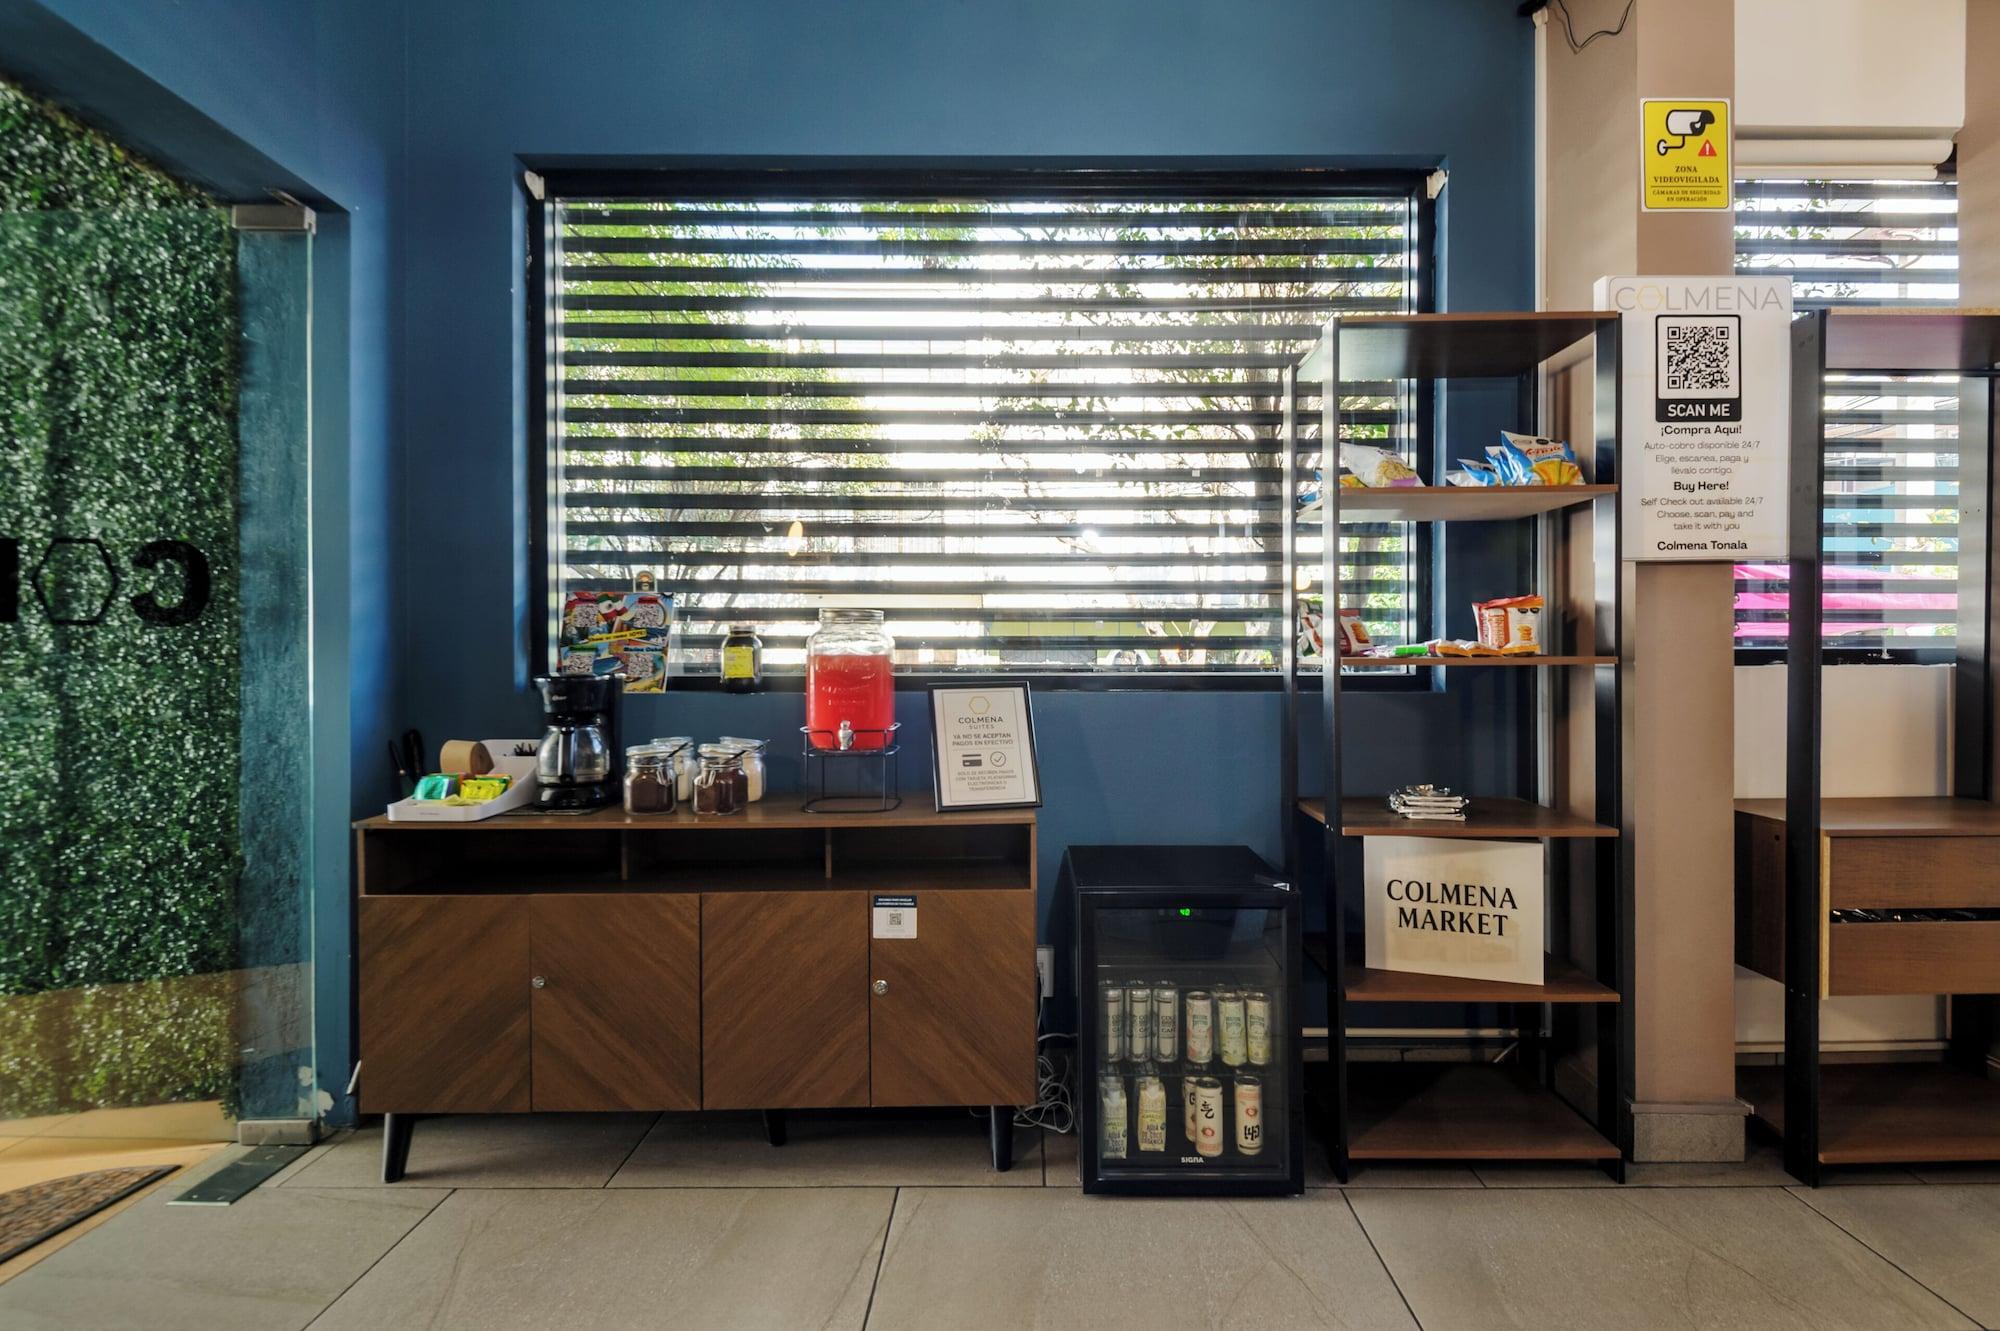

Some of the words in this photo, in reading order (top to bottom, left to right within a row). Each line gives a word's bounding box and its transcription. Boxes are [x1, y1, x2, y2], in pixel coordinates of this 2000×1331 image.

[1675, 165, 1698, 173] ZONA
[1615, 285, 1783, 311] COLMENA
[1667, 404, 1706, 417] SCAN
[1709, 403, 1731, 417] ME
[1661, 425, 1711, 436] ¡Compra
[1644, 442, 1695, 450] Auto-cobro
[1697, 440, 1740, 450] disponible
[1741, 440, 1761, 450] 24/7
[1720, 455, 1741, 464] paga
[1743, 456, 1749, 464] y
[1673, 481, 1695, 493] Buy
[1698, 481, 1729, 491] Here!
[1640, 497, 1657, 506] Self
[1660, 497, 1687, 506] Check
[1689, 497, 1704, 505] out
[1706, 496, 1743, 505] available
[1745, 496, 1764, 505] 24/7
[1719, 511, 1735, 520] pay
[1737, 510, 1754, 518] and
[1695, 522, 1702, 530] it
[1704, 522, 1722, 530] with
[1724, 523, 1740, 531] you
[1657, 541, 1708, 551] Colmena
[958, 716, 1004, 724] COLMENA
[1387, 880, 1518, 909] COLMENA
[1398, 907, 1508, 936] MARKET
